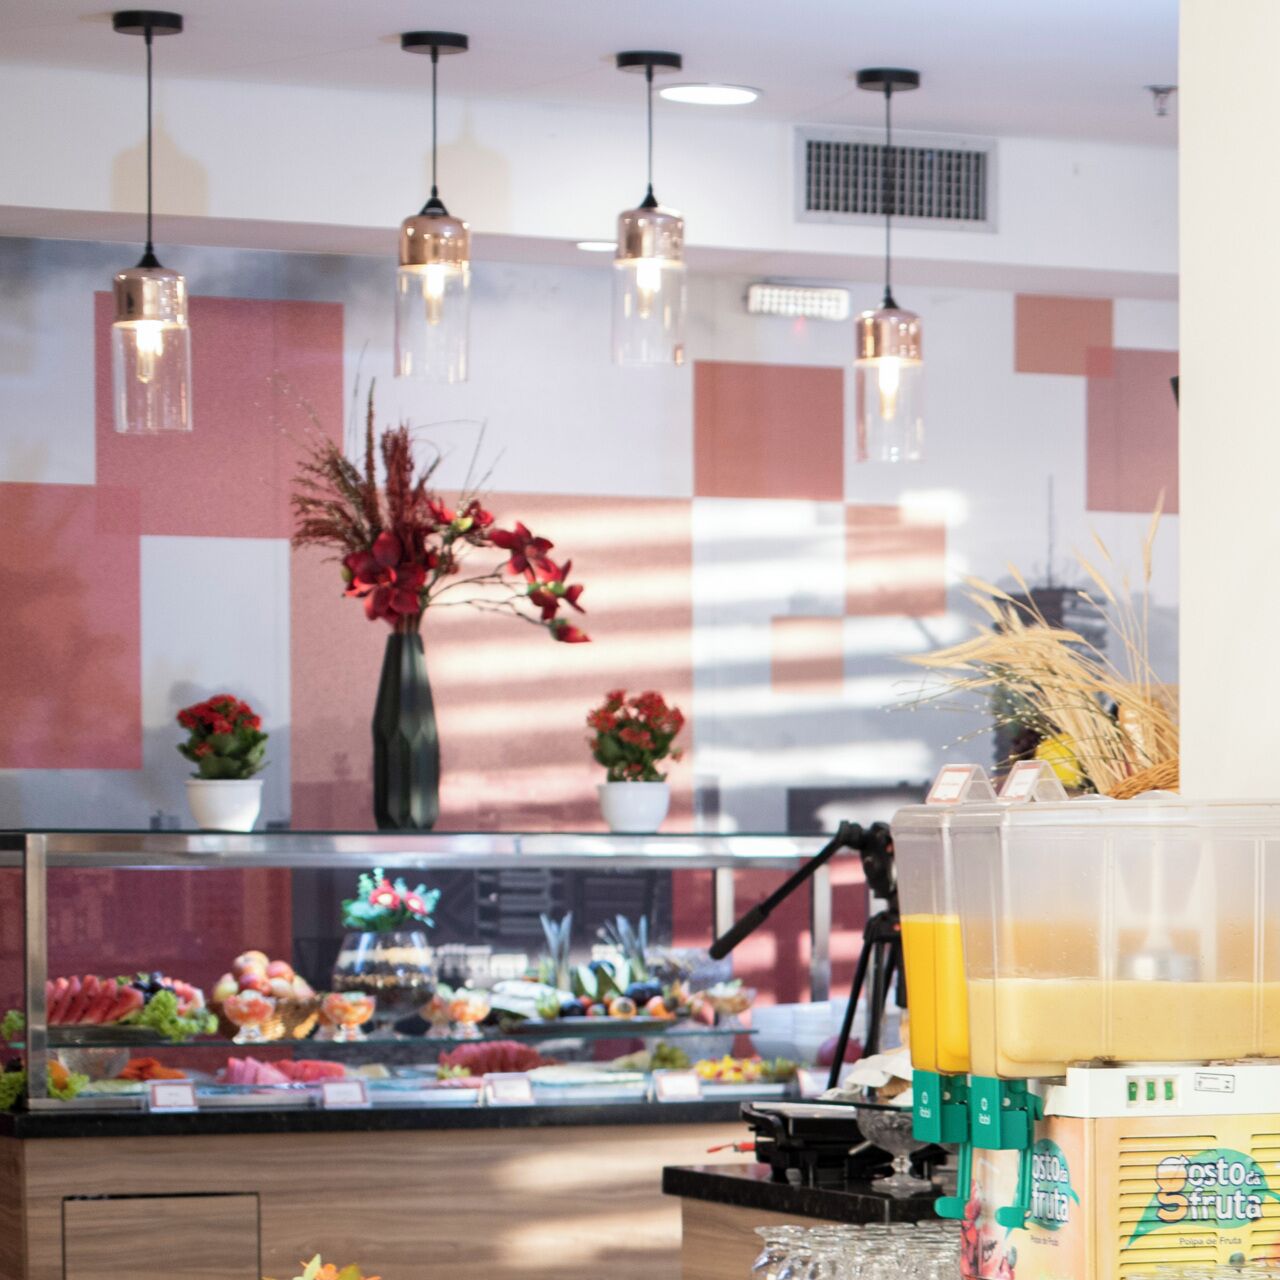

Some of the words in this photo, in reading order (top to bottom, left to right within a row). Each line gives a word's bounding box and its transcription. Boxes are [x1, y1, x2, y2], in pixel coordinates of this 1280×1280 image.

[1032, 1150, 1059, 1180] osto
[1156, 1154, 1246, 1222] gosto
[1245, 1170, 1262, 1185] da
[1188, 1186, 1263, 1220] fruta
[1179, 1237, 1204, 1248] Polpa
[1206, 1237, 1217, 1245] de
[1219, 1236, 1242, 1245] Fruta
